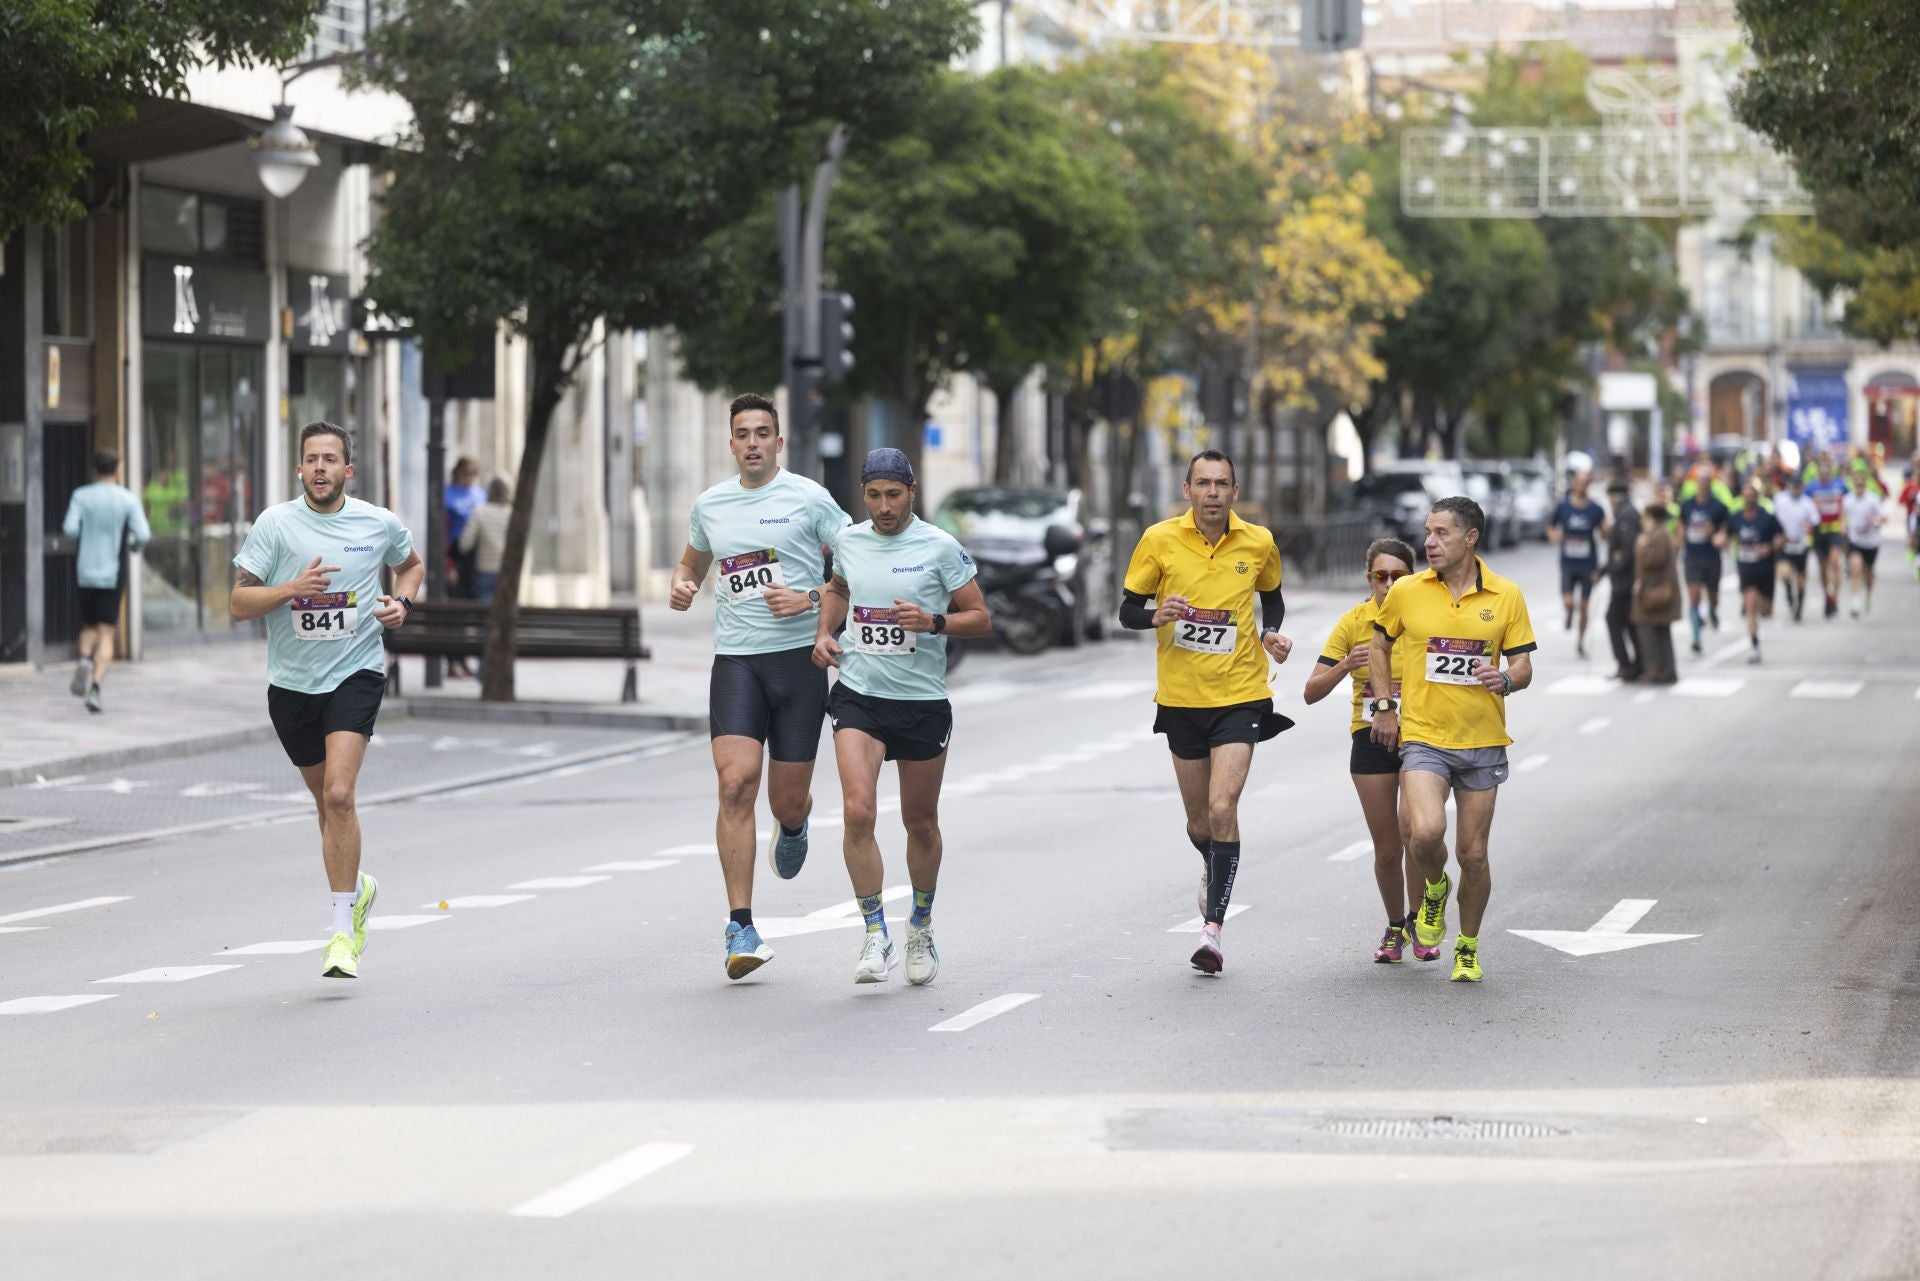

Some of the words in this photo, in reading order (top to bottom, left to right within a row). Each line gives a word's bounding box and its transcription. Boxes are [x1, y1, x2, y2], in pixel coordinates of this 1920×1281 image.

[760, 517, 789, 525] OneHealth
[892, 565, 925, 574] OneHealth
[729, 567, 773, 593] 840
[301, 611, 345, 631] 841
[861, 626, 905, 646] 839
[1182, 623, 1227, 645] 227
